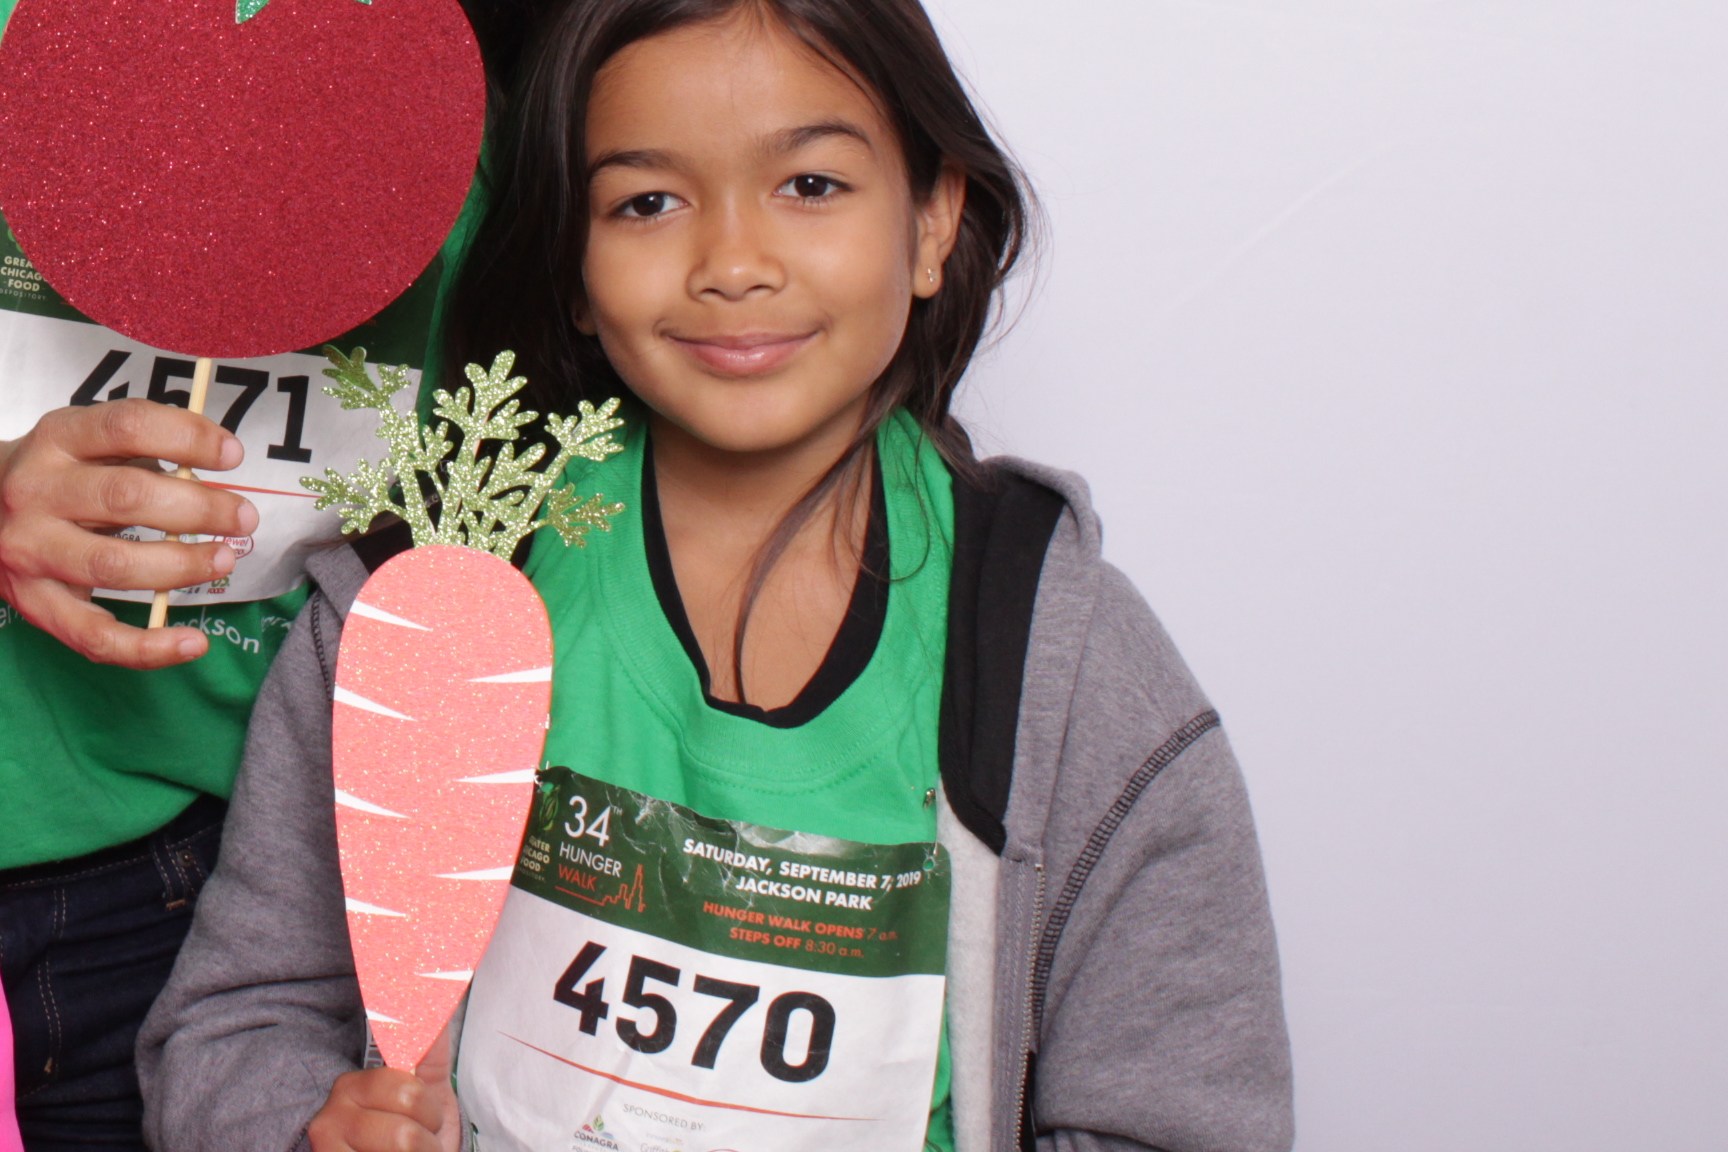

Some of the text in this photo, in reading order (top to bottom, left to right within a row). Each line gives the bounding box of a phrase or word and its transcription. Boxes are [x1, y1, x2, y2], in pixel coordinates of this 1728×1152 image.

[0, 266, 48, 283] CHICAG
[4, 256, 34, 269] GREA
[559, 841, 623, 878] HUNGER
[682, 838, 921, 891] SATURDAY, SEPTEMBER 7, 2019
[558, 863, 598, 891] WALK
[735, 875, 873, 910] JACKSON PARK
[703, 901, 765, 925] HUNGER
[768, 914, 812, 932] WALK
[815, 922, 864, 940] OPENS
[867, 927, 877, 940] 7
[730, 927, 864, 958] STEPS OFF 8:30 a.m.
[553, 940, 836, 1083] 4570
[623, 1103, 706, 1132] SPONSORED BY:
[574, 1131, 619, 1151] CONAGRA
